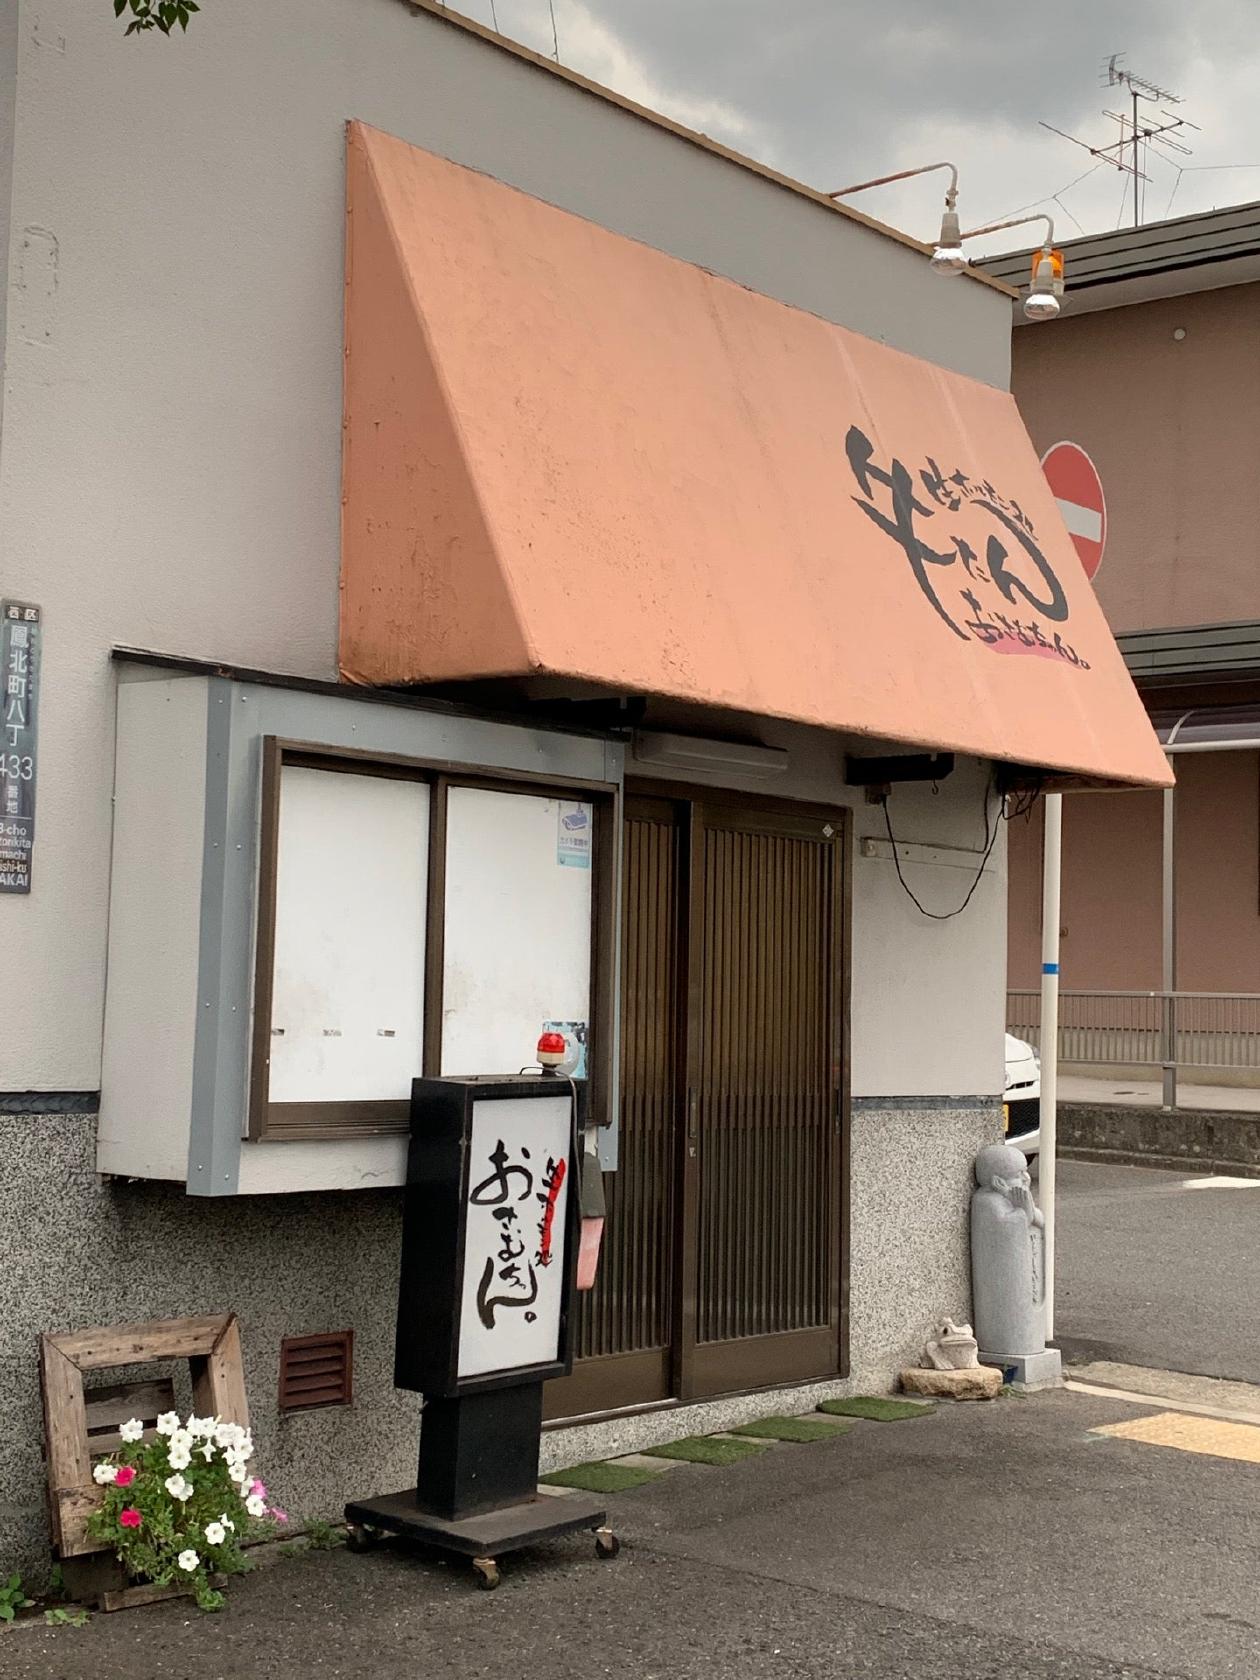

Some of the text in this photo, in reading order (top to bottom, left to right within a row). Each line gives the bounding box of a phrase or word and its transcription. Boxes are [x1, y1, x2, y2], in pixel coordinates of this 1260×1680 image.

[6, 624, 30, 747] 鳳北町八丁
